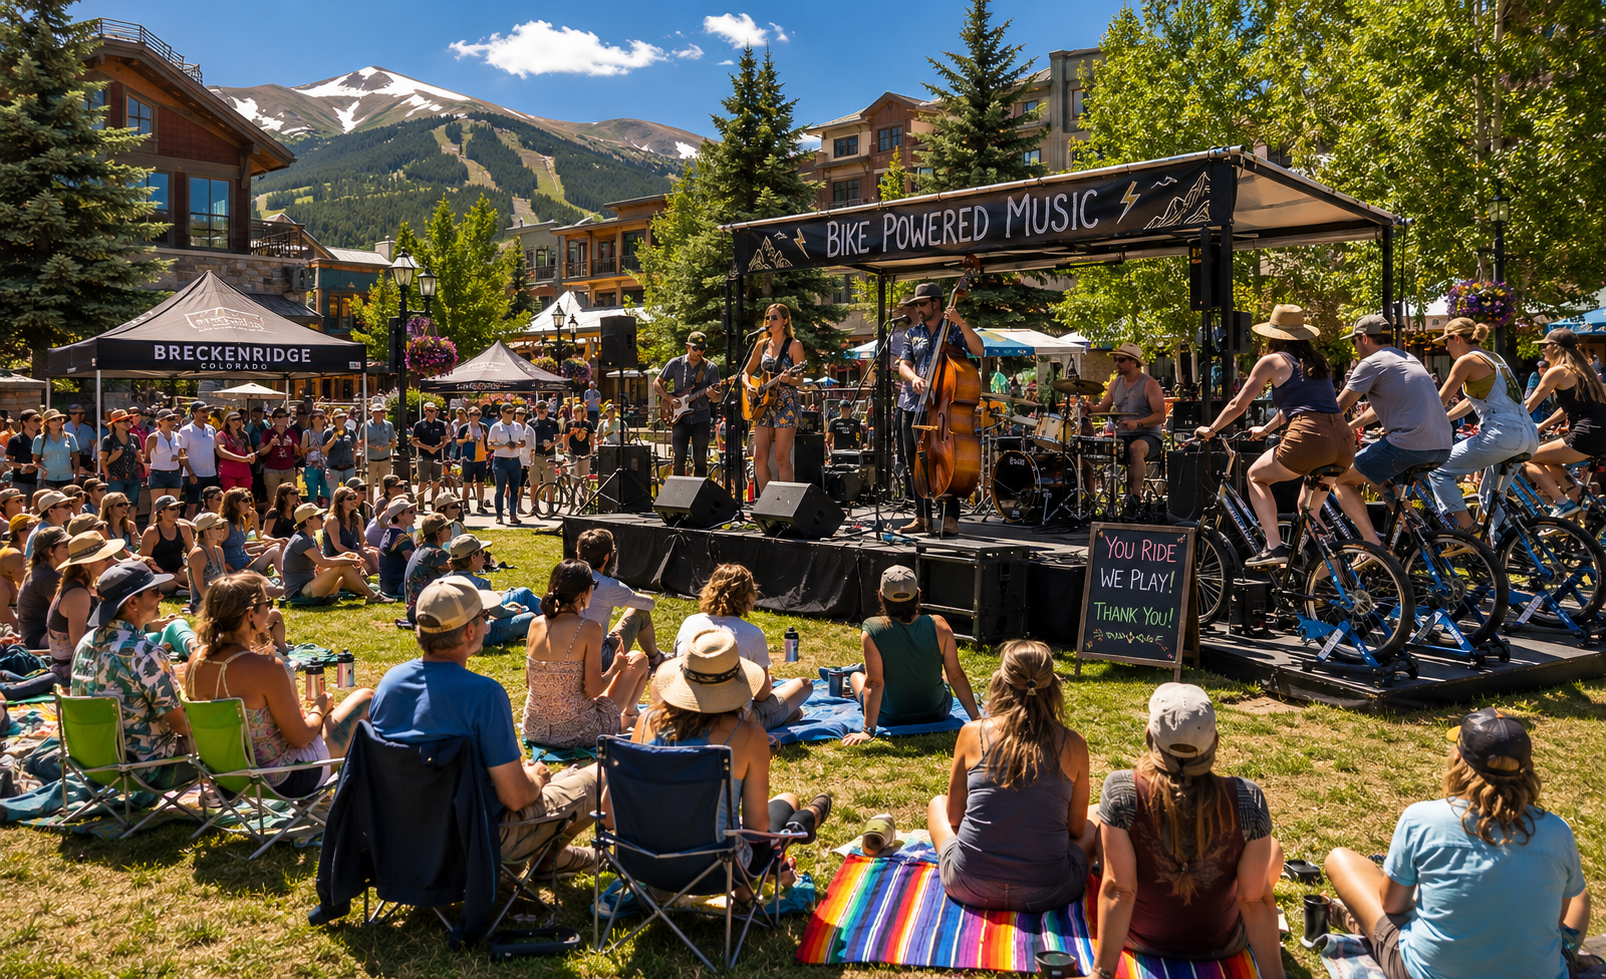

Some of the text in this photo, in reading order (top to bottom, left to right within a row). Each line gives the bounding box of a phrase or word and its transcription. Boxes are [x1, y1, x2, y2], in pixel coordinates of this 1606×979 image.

[827, 189, 1099, 258] BIKE POWERED MUSIC
[153, 344, 311, 363] BRECKENRIDGE
[200, 362, 268, 370] COLORADO
[1105, 535, 1177, 563] YOU RIDE
[1100, 567, 1175, 594] WE PLAY!
[1093, 602, 1174, 628] THANK YOU!
